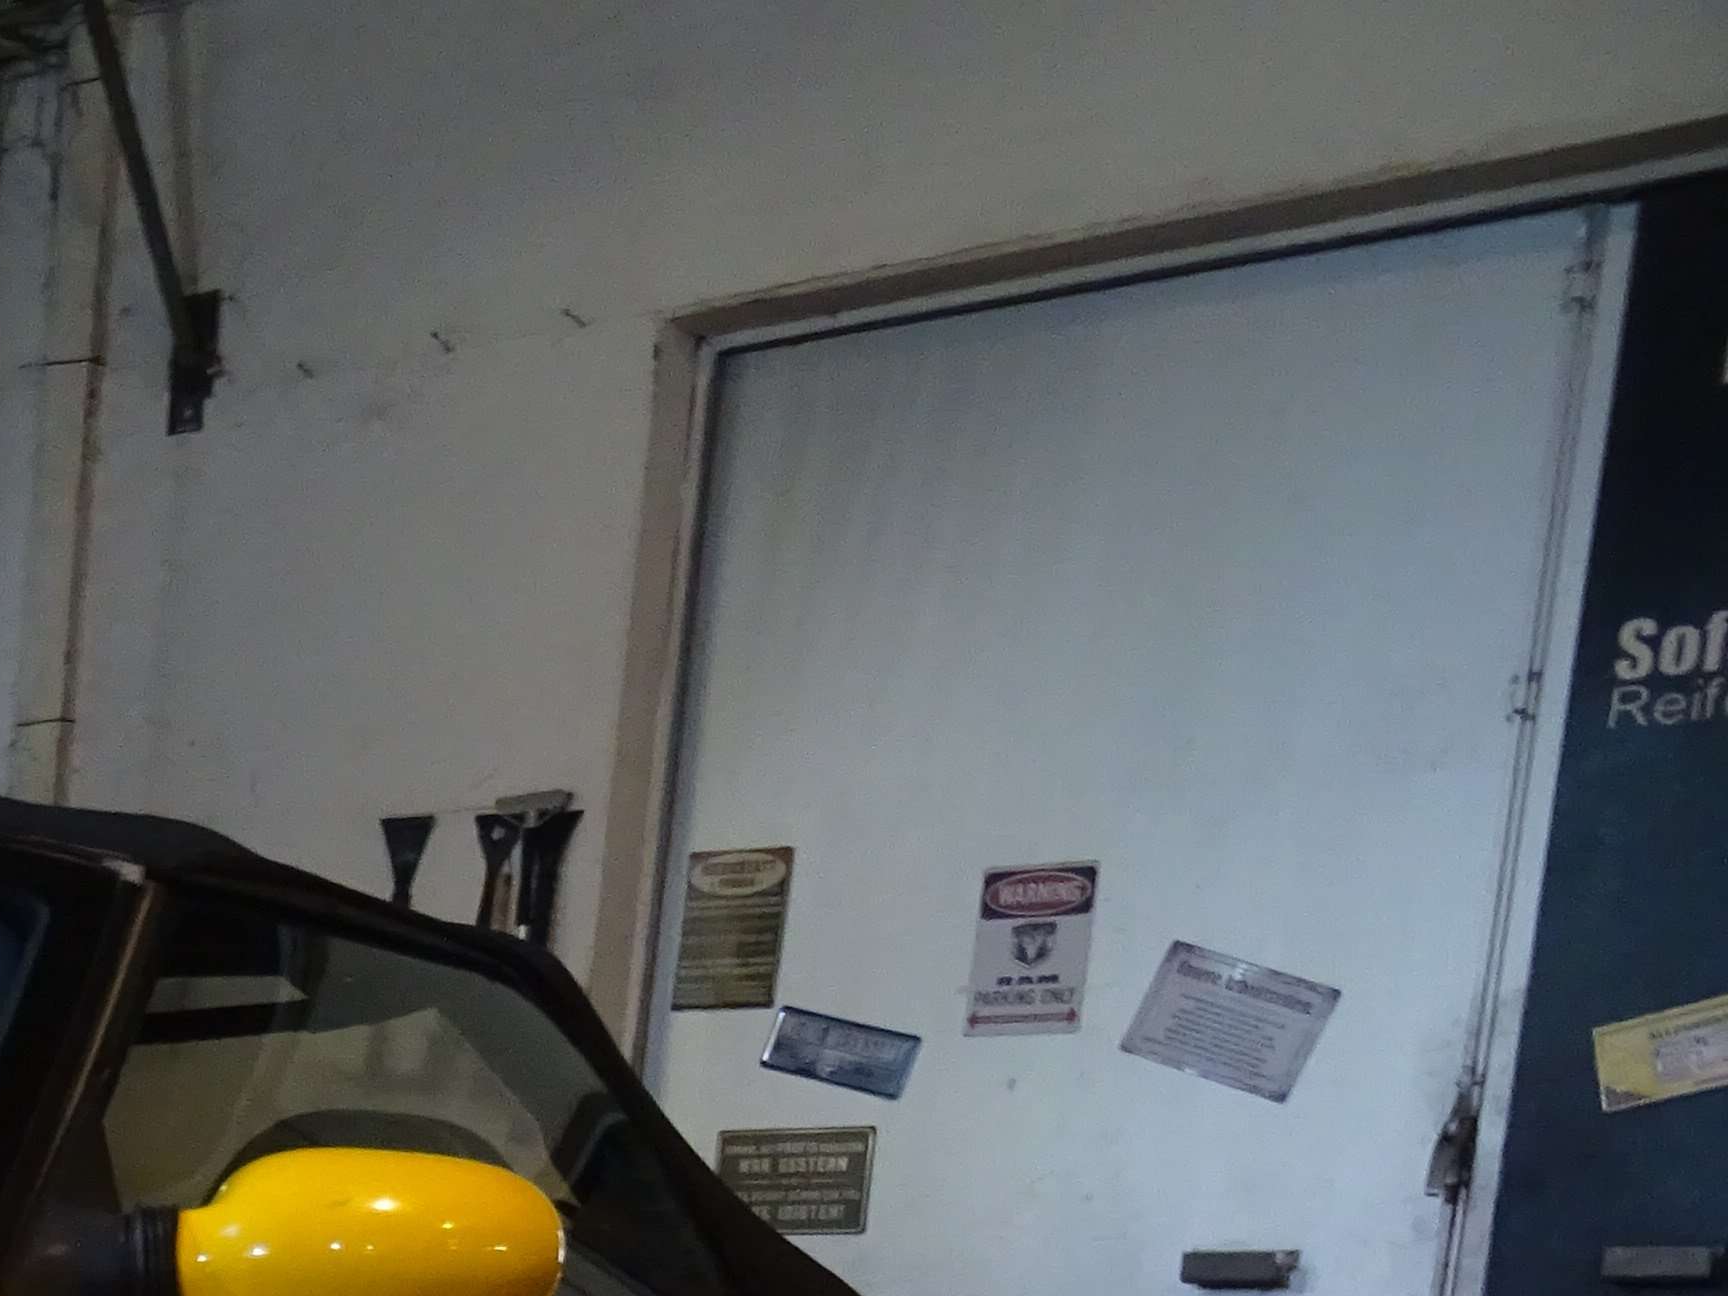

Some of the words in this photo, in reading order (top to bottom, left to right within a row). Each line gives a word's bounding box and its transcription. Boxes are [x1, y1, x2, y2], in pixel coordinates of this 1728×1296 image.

[1606, 676, 1728, 729] Reif
[997, 880, 1084, 906] WARNING
[973, 988, 1036, 1006] PARKING
[1040, 987, 1076, 1005] ONLY
